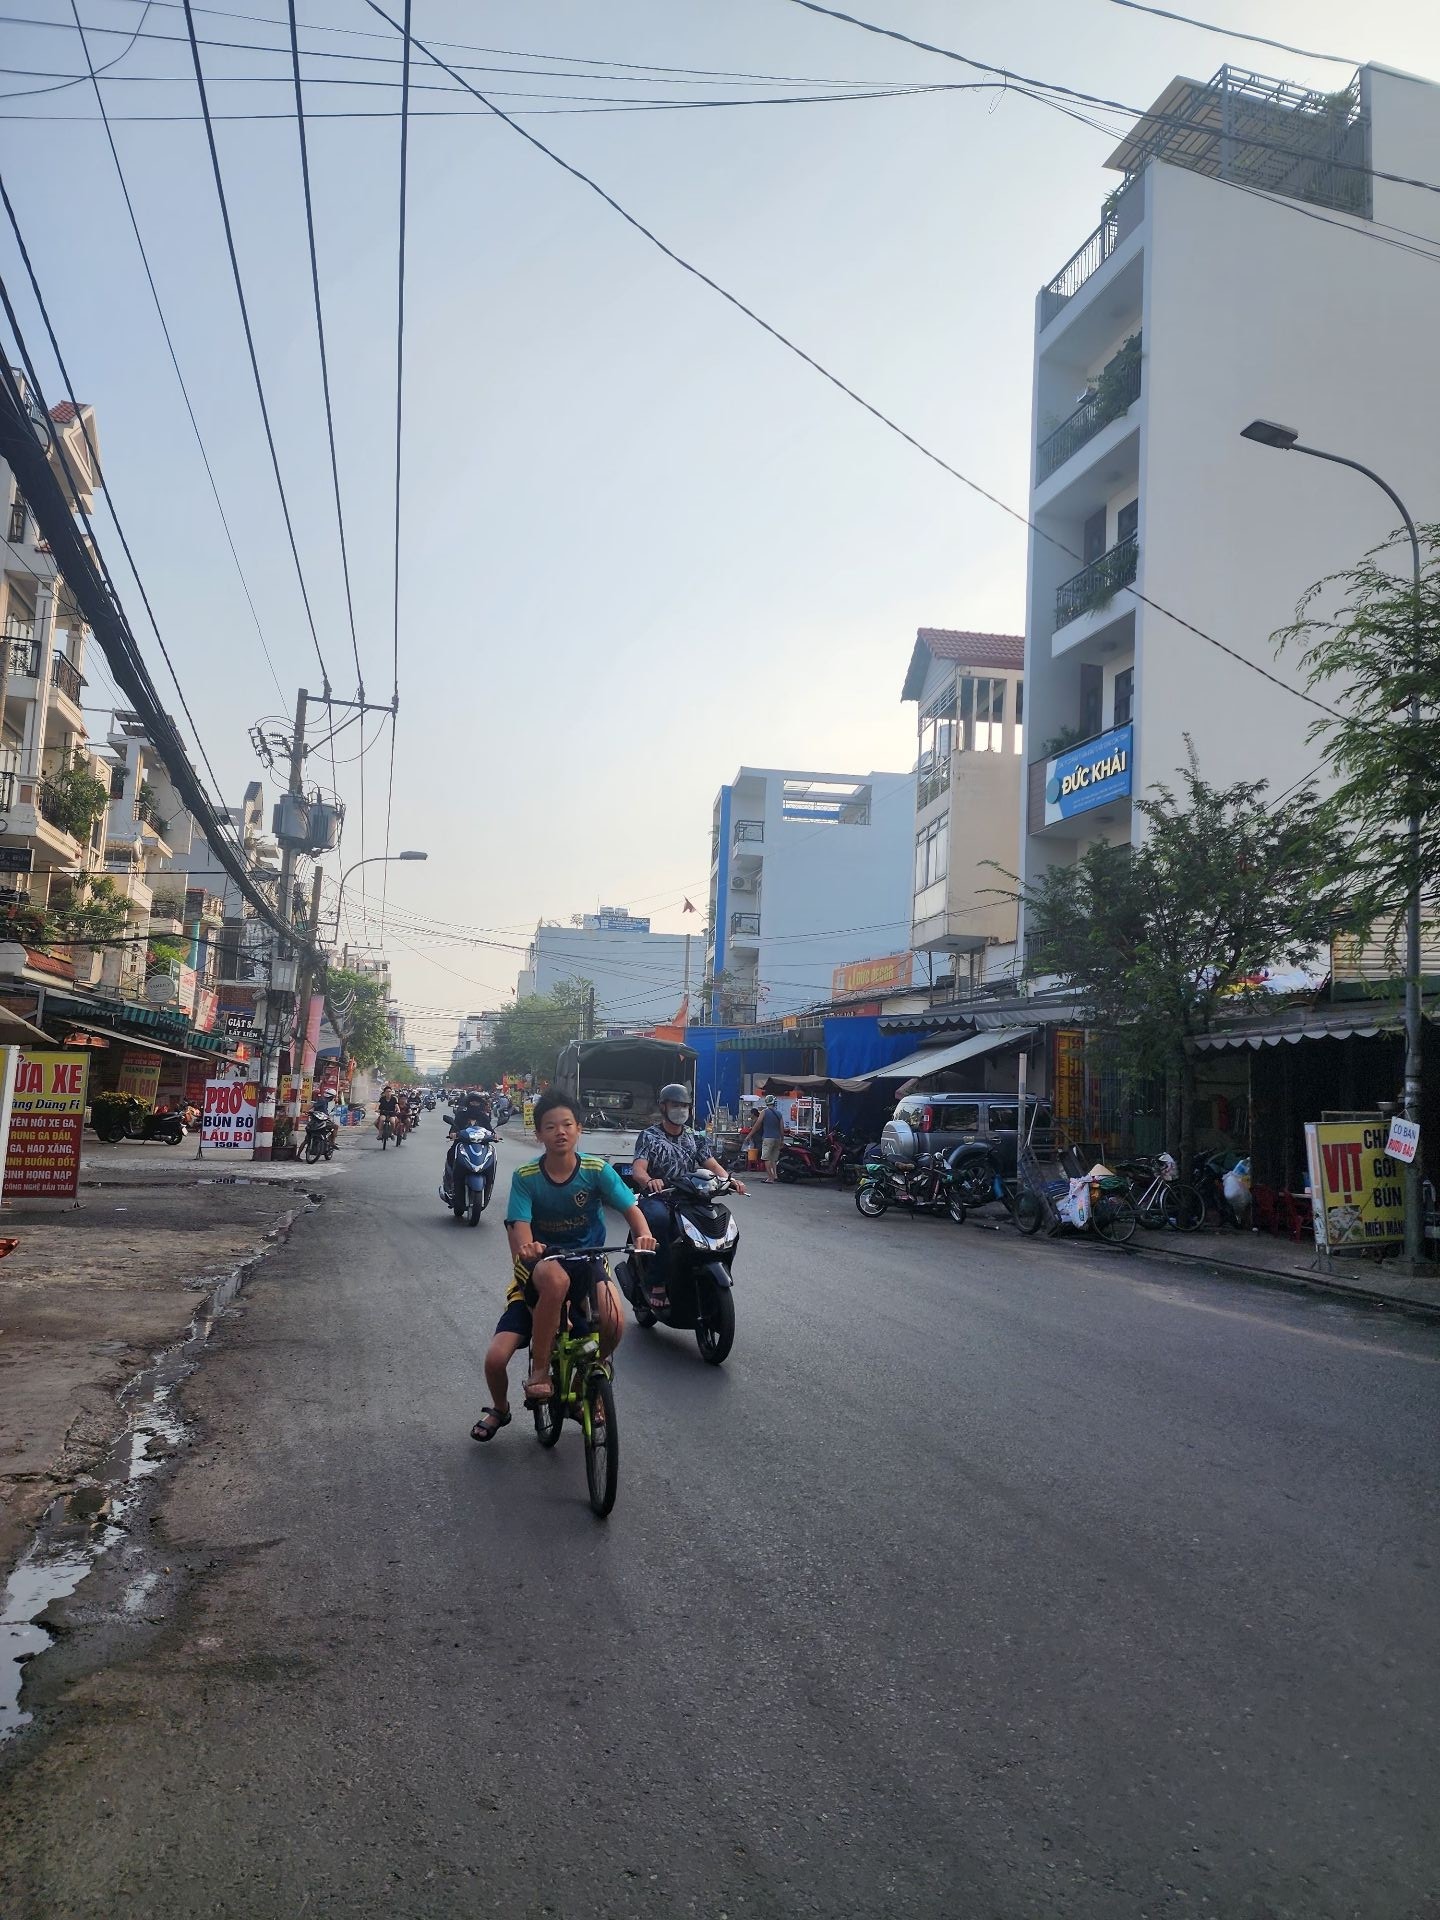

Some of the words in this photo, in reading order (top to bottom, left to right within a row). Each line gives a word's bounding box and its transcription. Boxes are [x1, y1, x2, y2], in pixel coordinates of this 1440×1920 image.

[1062, 765, 1089, 795] ĐỨC
[1092, 747, 1126, 783] KHẢI
[14, 1055, 43, 1094] ỬA
[52, 1064, 83, 1094] XE
[48, 1118, 60, 1128] XE
[62, 1119, 77, 1129] GA,
[203, 1114, 232, 1128] BÚN
[236, 1114, 254, 1128] BÒ
[11, 1131, 35, 1140] RUNG
[38, 1131, 49, 1140] GA
[234, 1129, 253, 1142] BÒ
[27, 1144, 45, 1153] HAO
[1321, 1142, 1363, 1204] VỊT
[1373, 1183, 1402, 1208] BÚN
